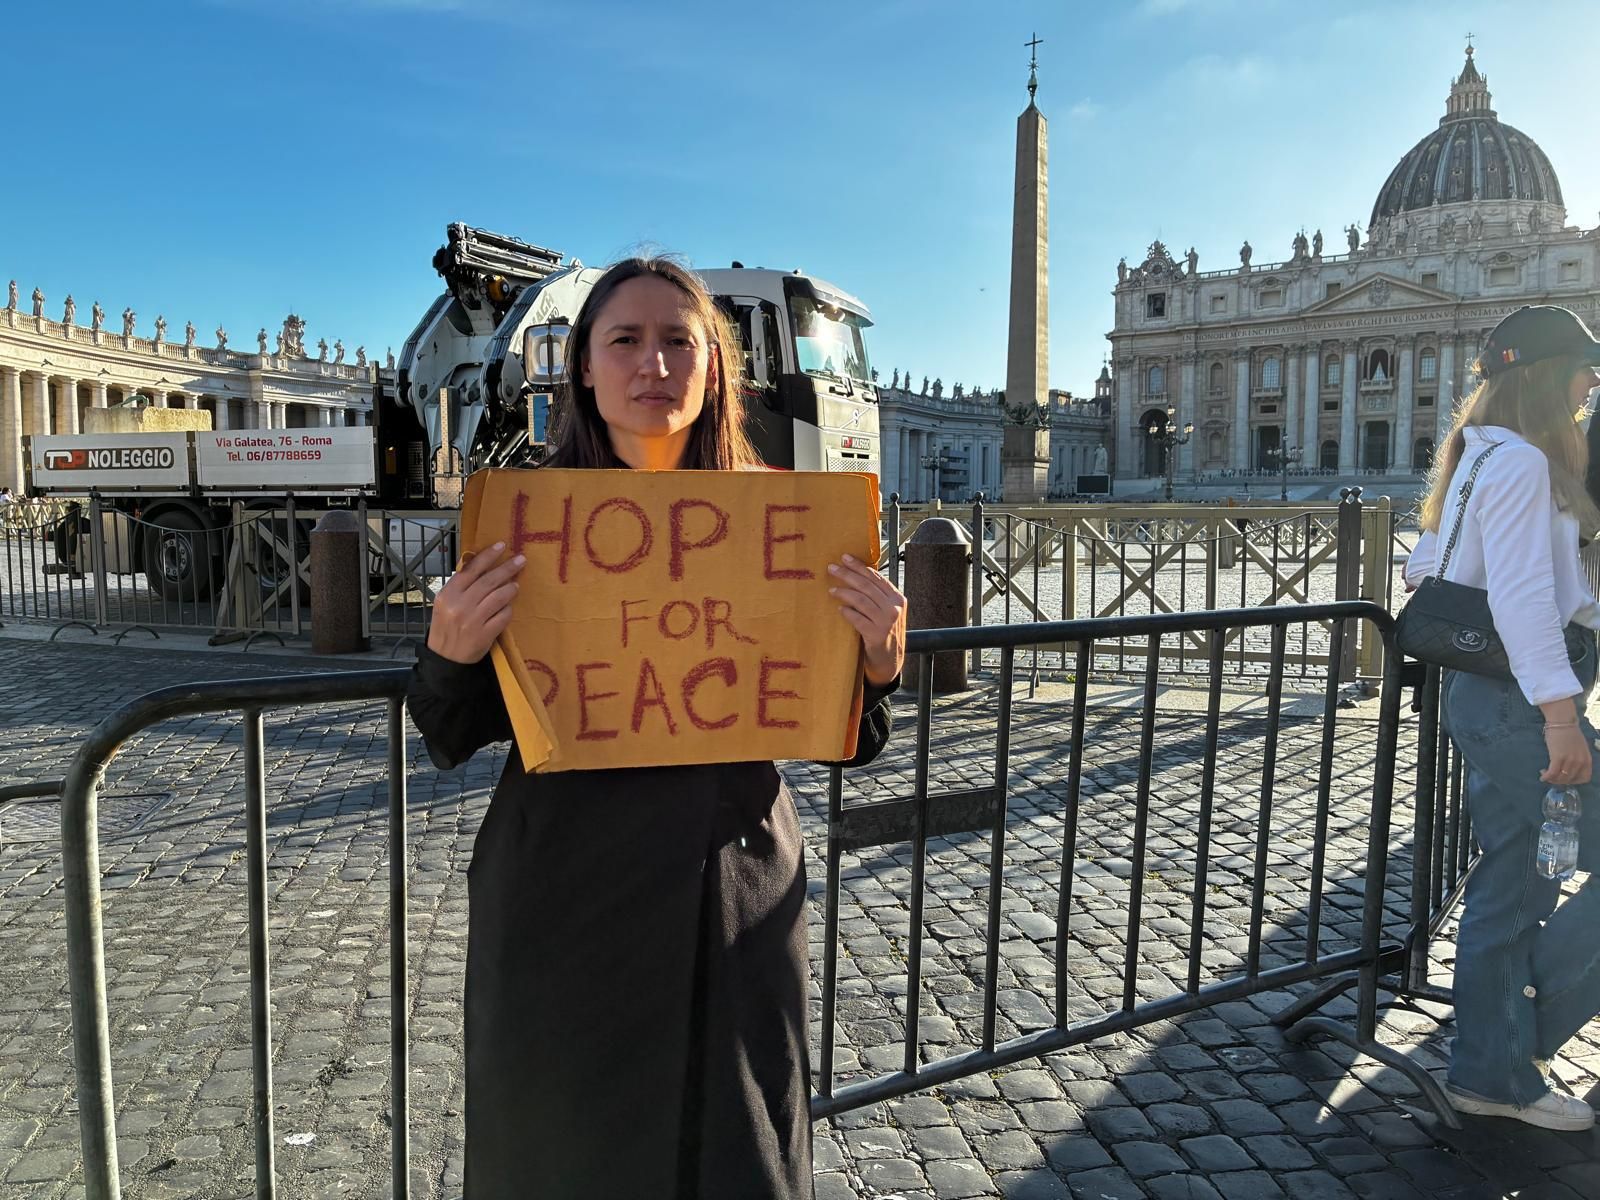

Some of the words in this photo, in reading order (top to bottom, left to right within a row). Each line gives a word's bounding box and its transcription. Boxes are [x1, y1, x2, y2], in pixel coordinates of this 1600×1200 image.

[215, 437, 232, 448] Via
[234, 436, 276, 448] Galatea,
[278, 436, 292, 446] 76
[302, 435, 332, 446] Roma
[88, 448, 172, 468] NOLEGGIO
[226, 451, 244, 462] Tel.
[246, 450, 322, 462] 06/87788659
[510, 489, 815, 583] HOPE
[620, 597, 759, 649] FOR
